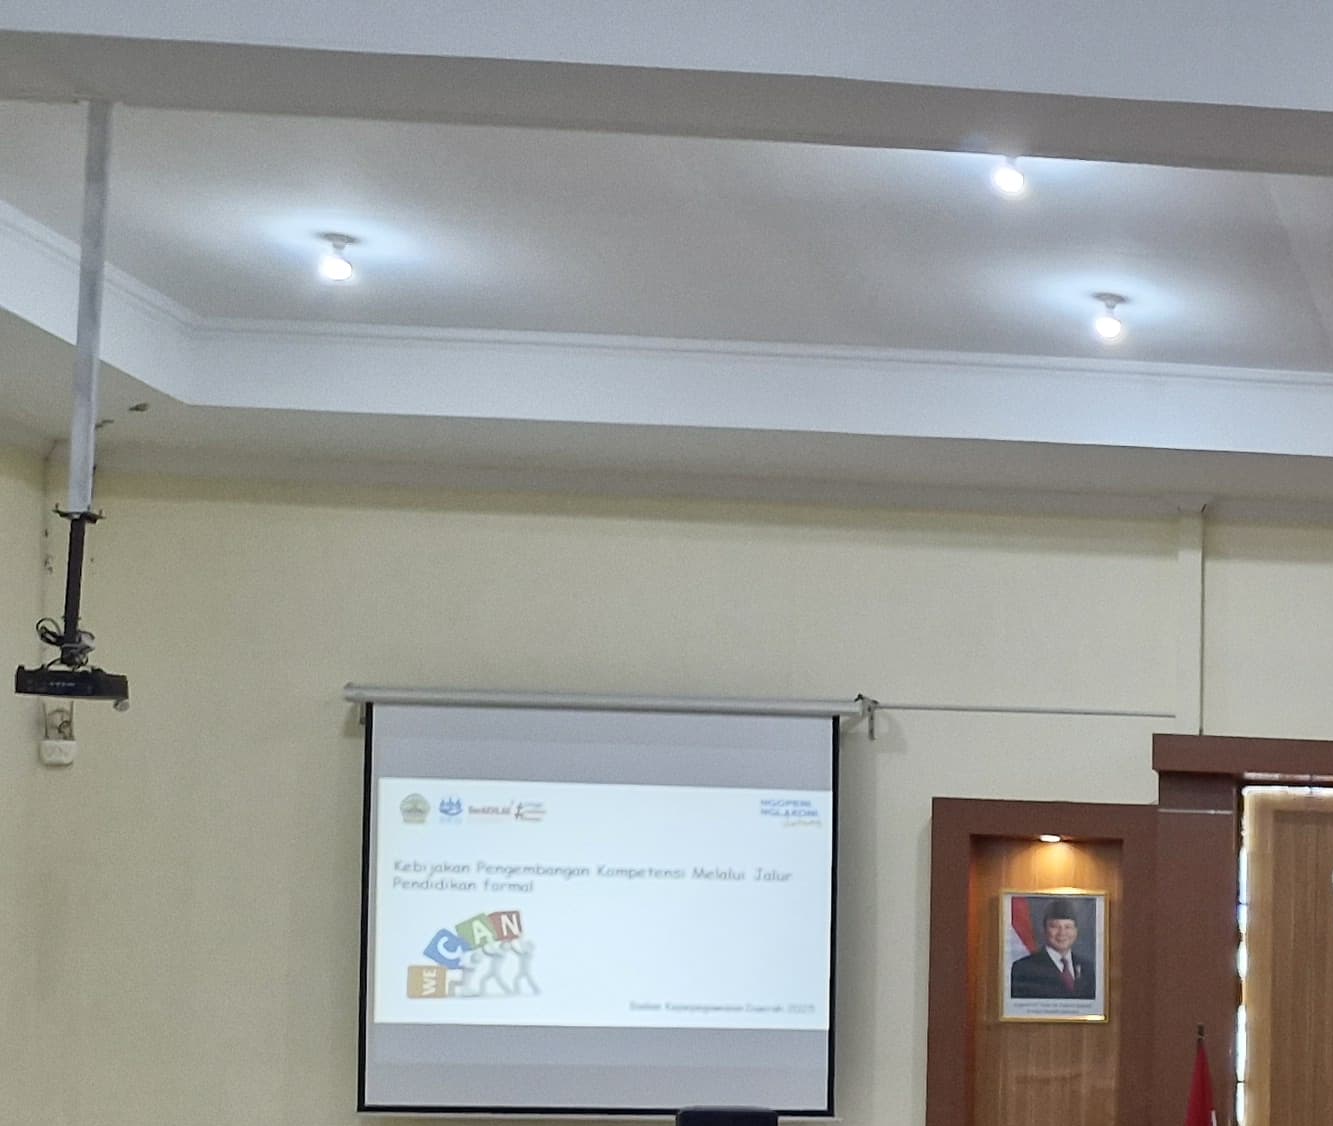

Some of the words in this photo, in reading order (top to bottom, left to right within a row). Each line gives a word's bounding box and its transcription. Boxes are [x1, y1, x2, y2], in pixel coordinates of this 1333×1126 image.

[393, 861, 470, 879] Kebijakan
[476, 861, 590, 880] Pengembangan
[597, 864, 686, 882] Kompetensi
[691, 867, 746, 882] Melalui
[753, 867, 793, 883] Jalur
[392, 877, 477, 891] Pendidikan
[421, 968, 437, 996] WE
